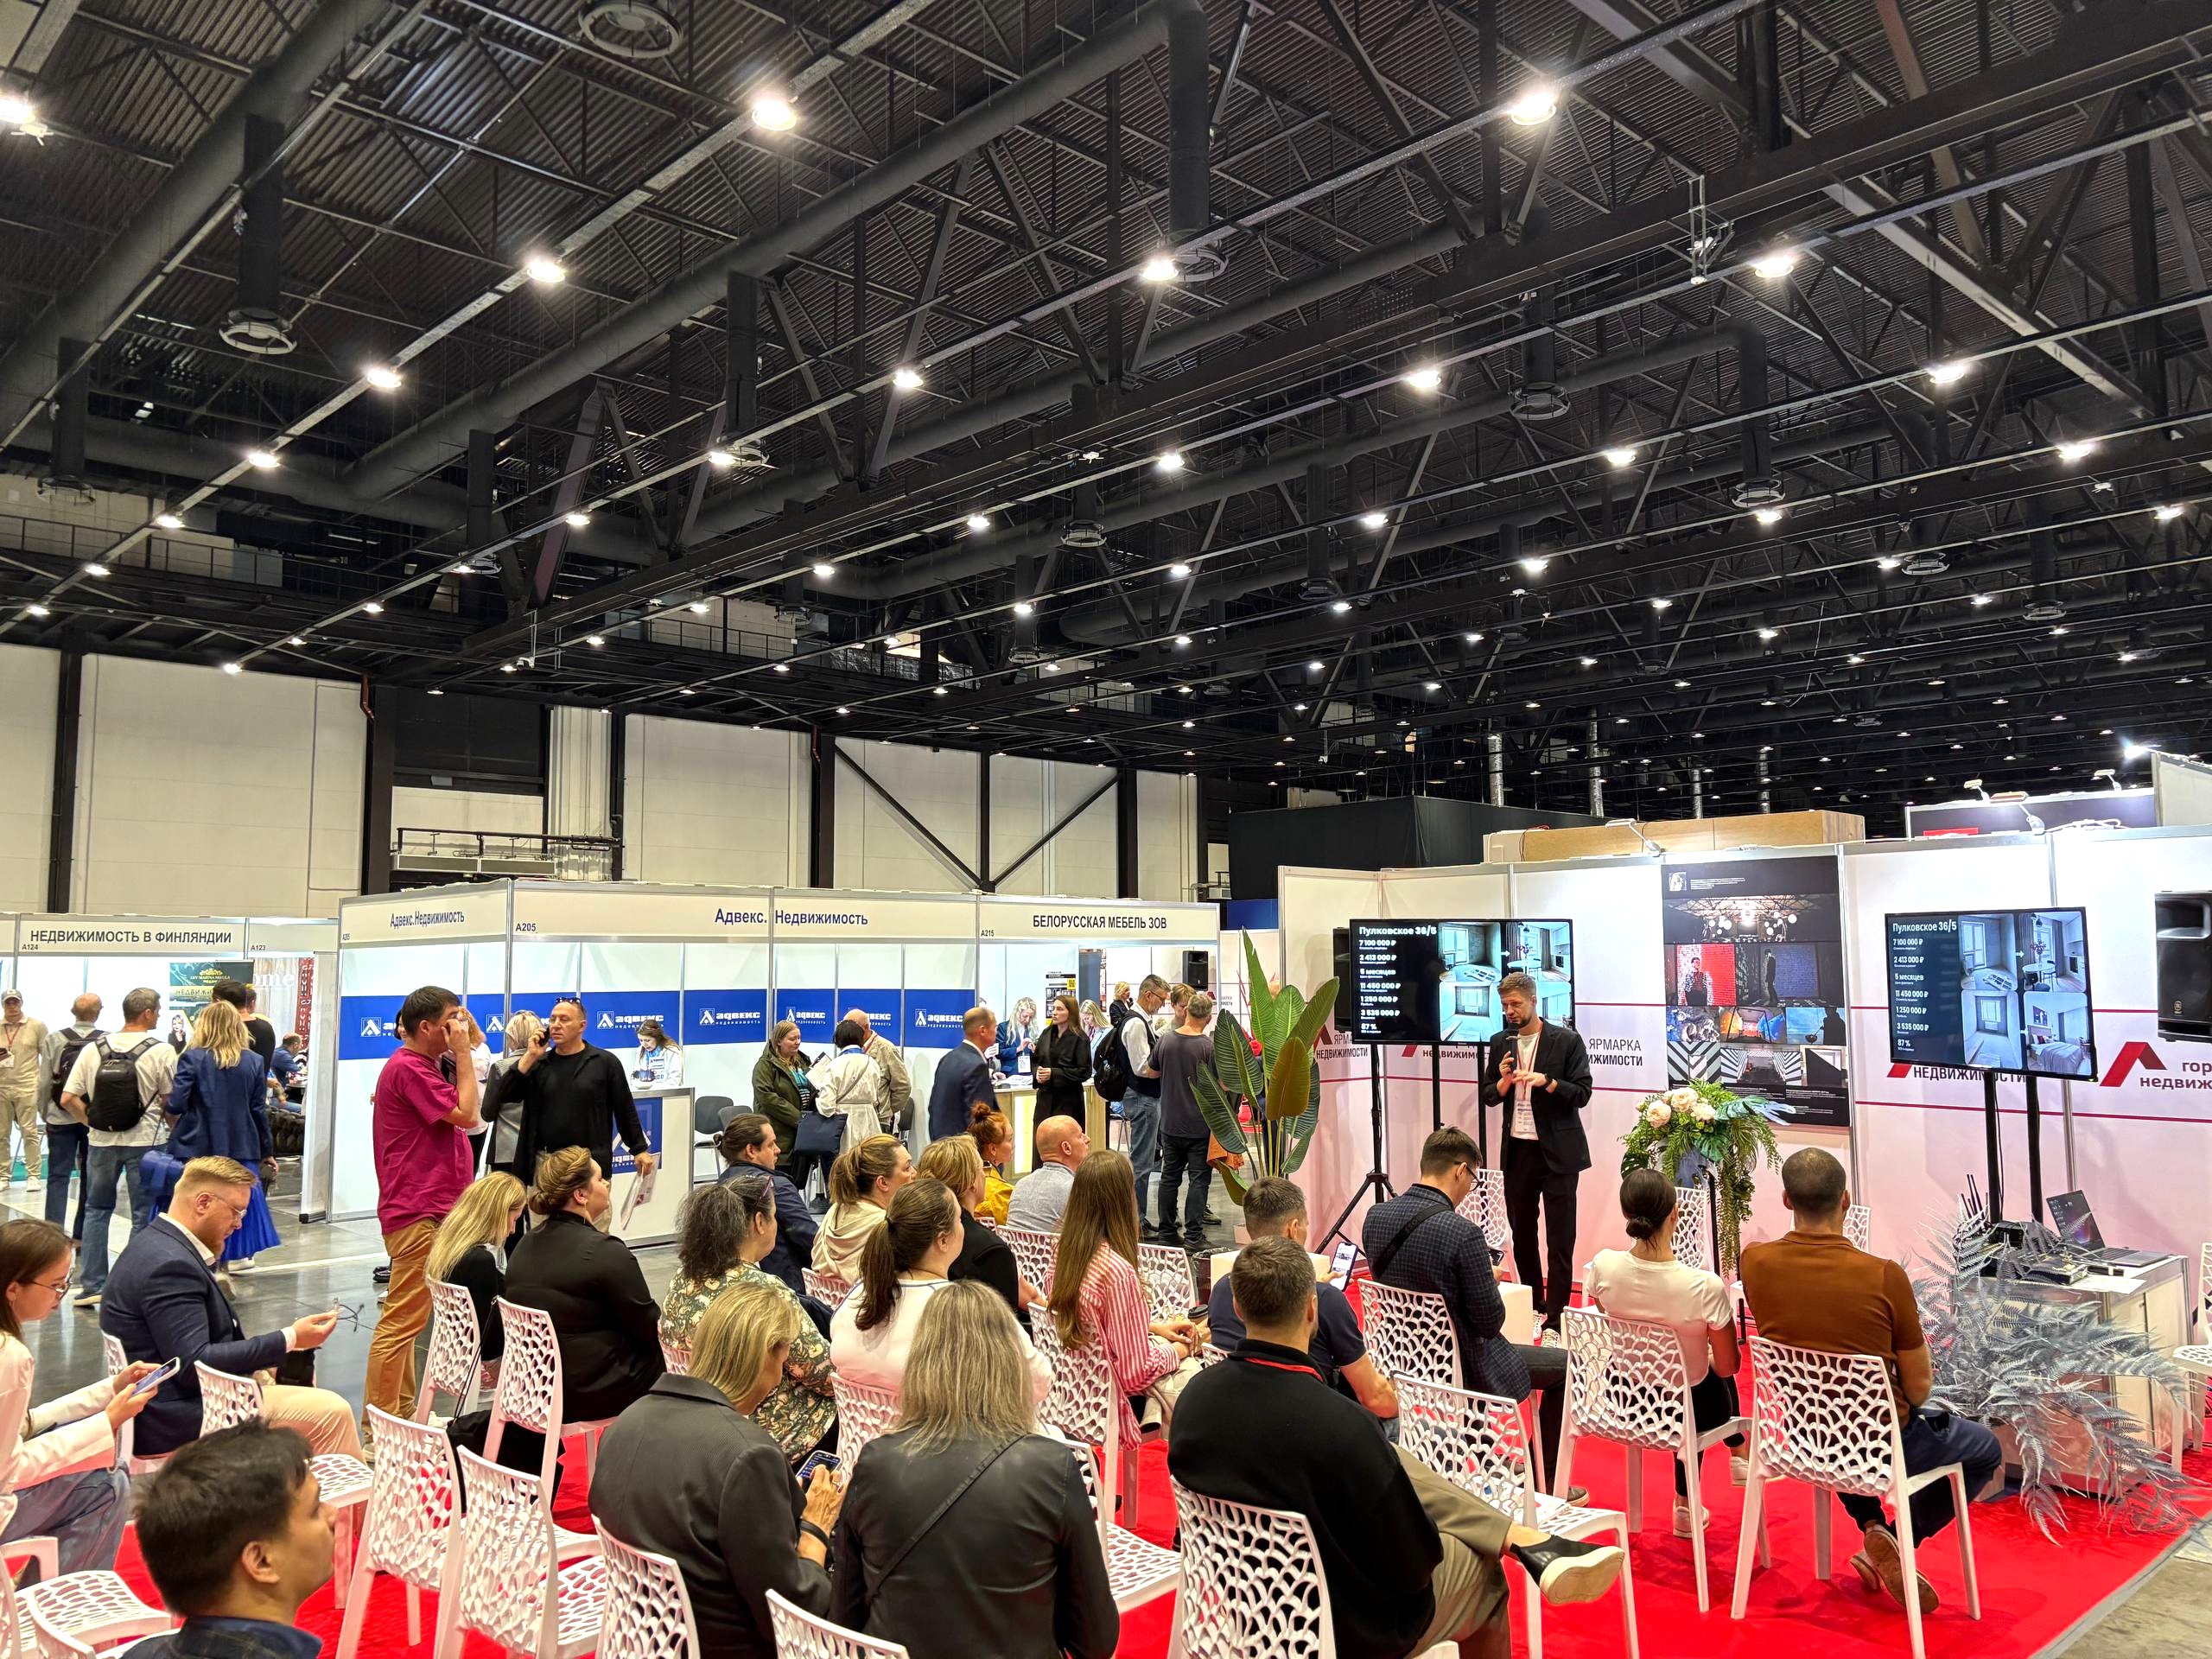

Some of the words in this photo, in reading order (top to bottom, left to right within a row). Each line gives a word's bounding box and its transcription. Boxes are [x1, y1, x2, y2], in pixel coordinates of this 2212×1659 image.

[390, 910, 465, 928] Адвекс.Недвижимость
[715, 907, 767, 925] Адвекс.
[775, 910, 868, 926] Недвижимость
[1033, 915, 1105, 928] БЕЛОРУССКАЯ
[1108, 916, 1147, 929] МЕБЕЛЬ
[1148, 917, 1167, 929] ЗОВ
[515, 923, 537, 932] A205
[1359, 926, 1414, 937] Пулковское
[1892, 923, 1937, 934] Пулковское
[1938, 919, 1957, 932] 36/5
[30, 930, 139, 944] НЕДВИЖИМОСТЬ
[143, 931, 151, 942] В
[155, 932, 232, 944] ФИНЛЯНДИИ
[1589, 1038, 1642, 1052] ЯРМАРКА
[1316, 1047, 1369, 1060] НЕДВИЖИМОСТИ
[2140, 1077, 2212, 1090] недвиж
